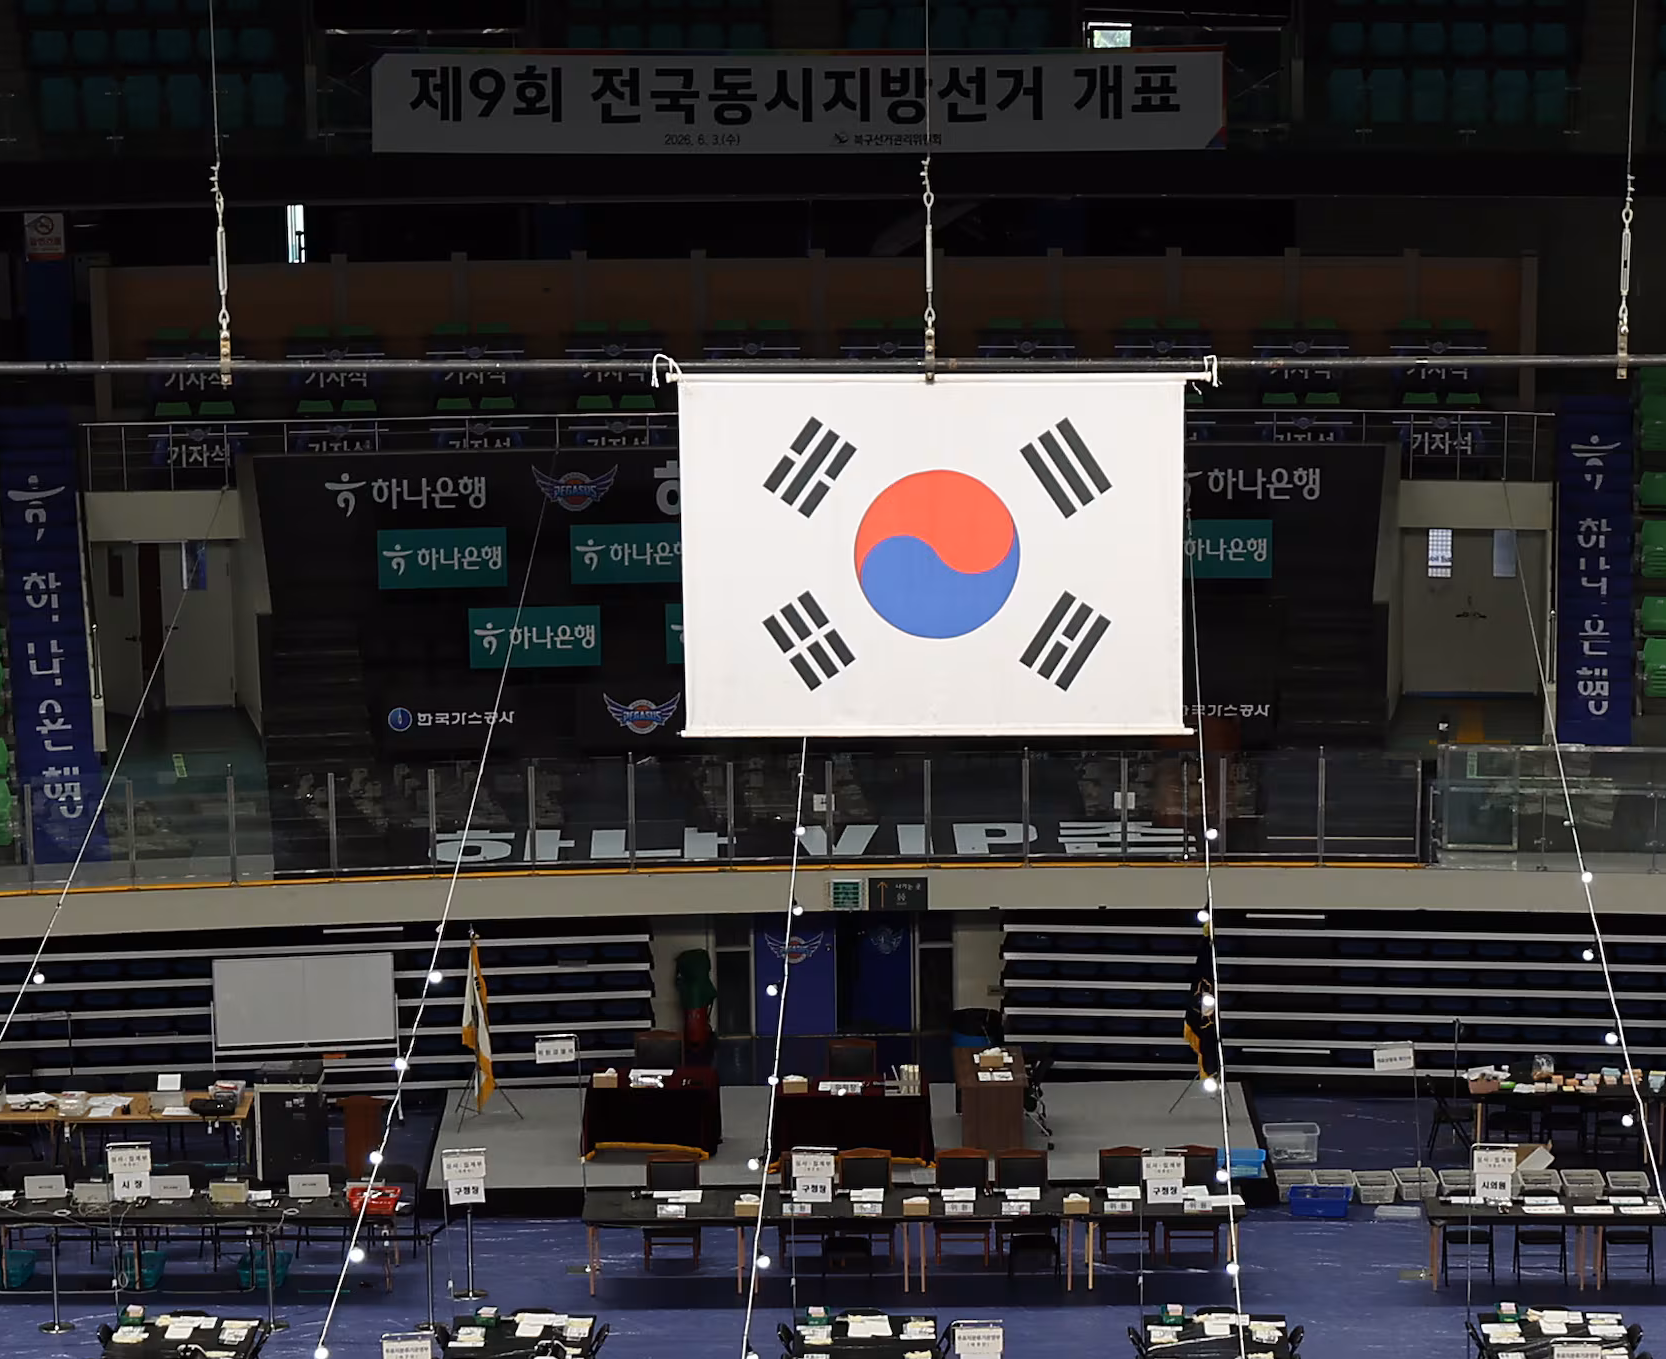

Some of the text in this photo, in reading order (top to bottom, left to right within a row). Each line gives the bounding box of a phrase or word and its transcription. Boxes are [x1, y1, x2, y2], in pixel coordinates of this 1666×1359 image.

[410, 65, 1180, 125] 제9회 전국동시지방선거 개표
[167, 443, 230, 468] 기자석
[1412, 432, 1473, 455] 기자석
[371, 476, 486, 510] 하나은행
[1207, 467, 1321, 501] 하나은행
[417, 545, 502, 570] 하나은행
[1184, 537, 1268, 562] 하나은행
[509, 624, 595, 650] 하나은행
[416, 711, 514, 727] 한국가스공사
[430, 826, 737, 863] 하나
[454, 1186, 479, 1195] 구청장
[802, 1185, 826, 1194] 구청장
[1152, 1187, 1177, 1195] 구청장
[1481, 1181, 1506, 1190] 시의원
